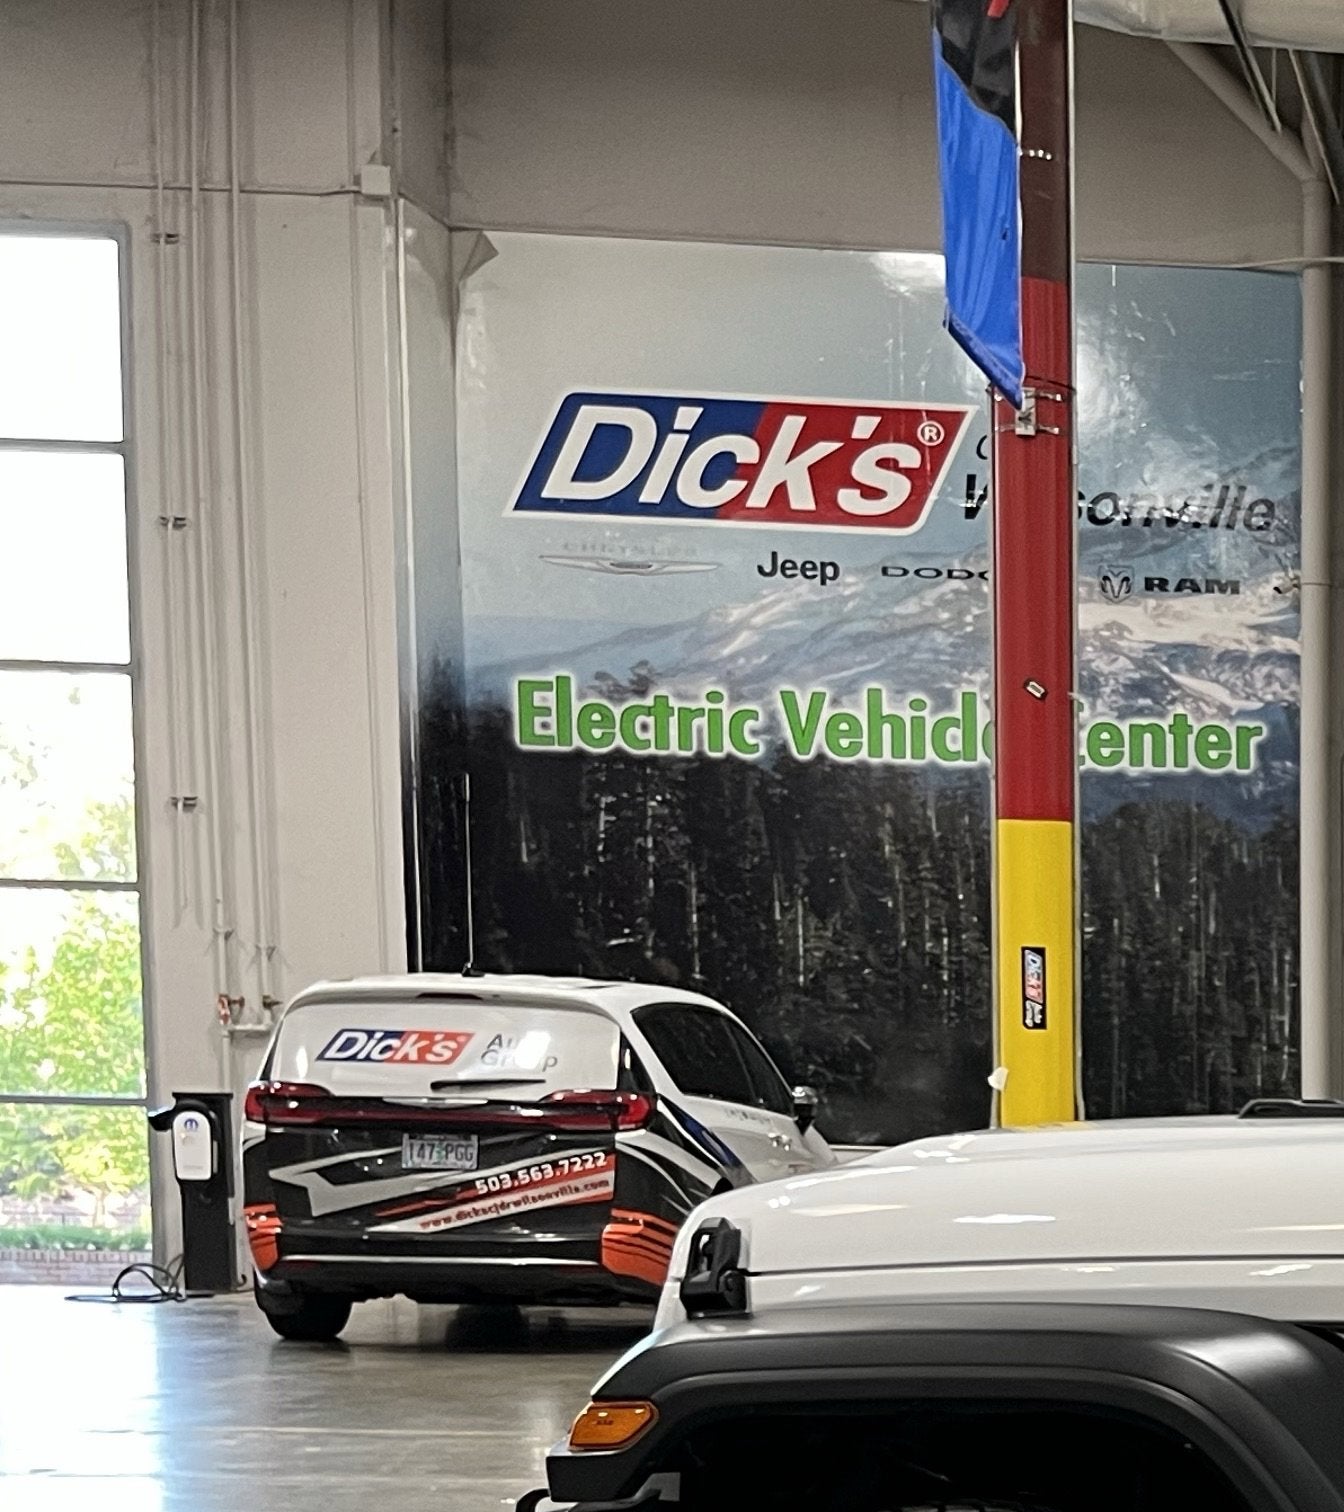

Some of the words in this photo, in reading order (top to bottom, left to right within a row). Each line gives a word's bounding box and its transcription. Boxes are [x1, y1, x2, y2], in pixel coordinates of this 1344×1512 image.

[757, 551, 840, 586] Jeep
[881, 565, 988, 582] DOD
[1144, 576, 1241, 595] RAM
[517, 675, 760, 755] Electric
[1078, 700, 1263, 771] enter
[475, 1151, 608, 1195] 503.563.7222
